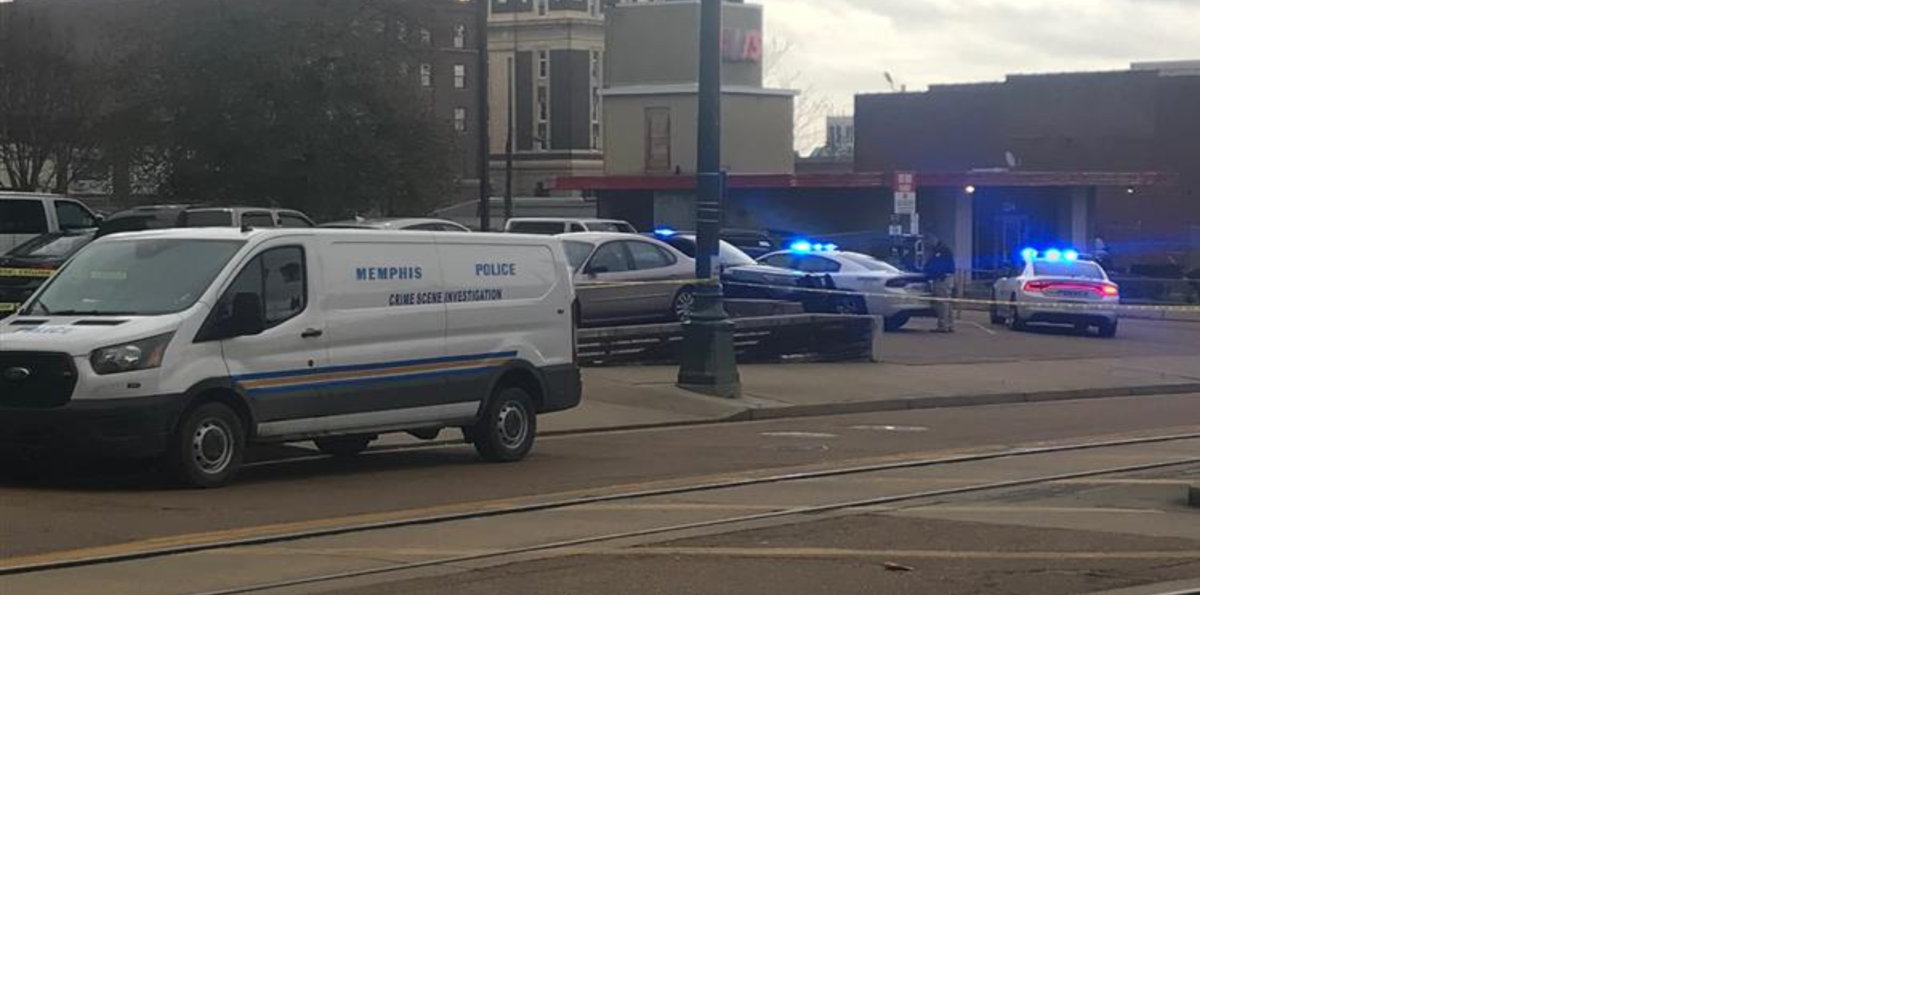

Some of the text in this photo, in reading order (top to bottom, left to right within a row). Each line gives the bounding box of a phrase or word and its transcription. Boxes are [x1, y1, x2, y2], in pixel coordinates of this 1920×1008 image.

[355, 262, 516, 281] MEMPHIS POLICE
[389, 288, 502, 306] CRIME SCENE INVESTIGATION
